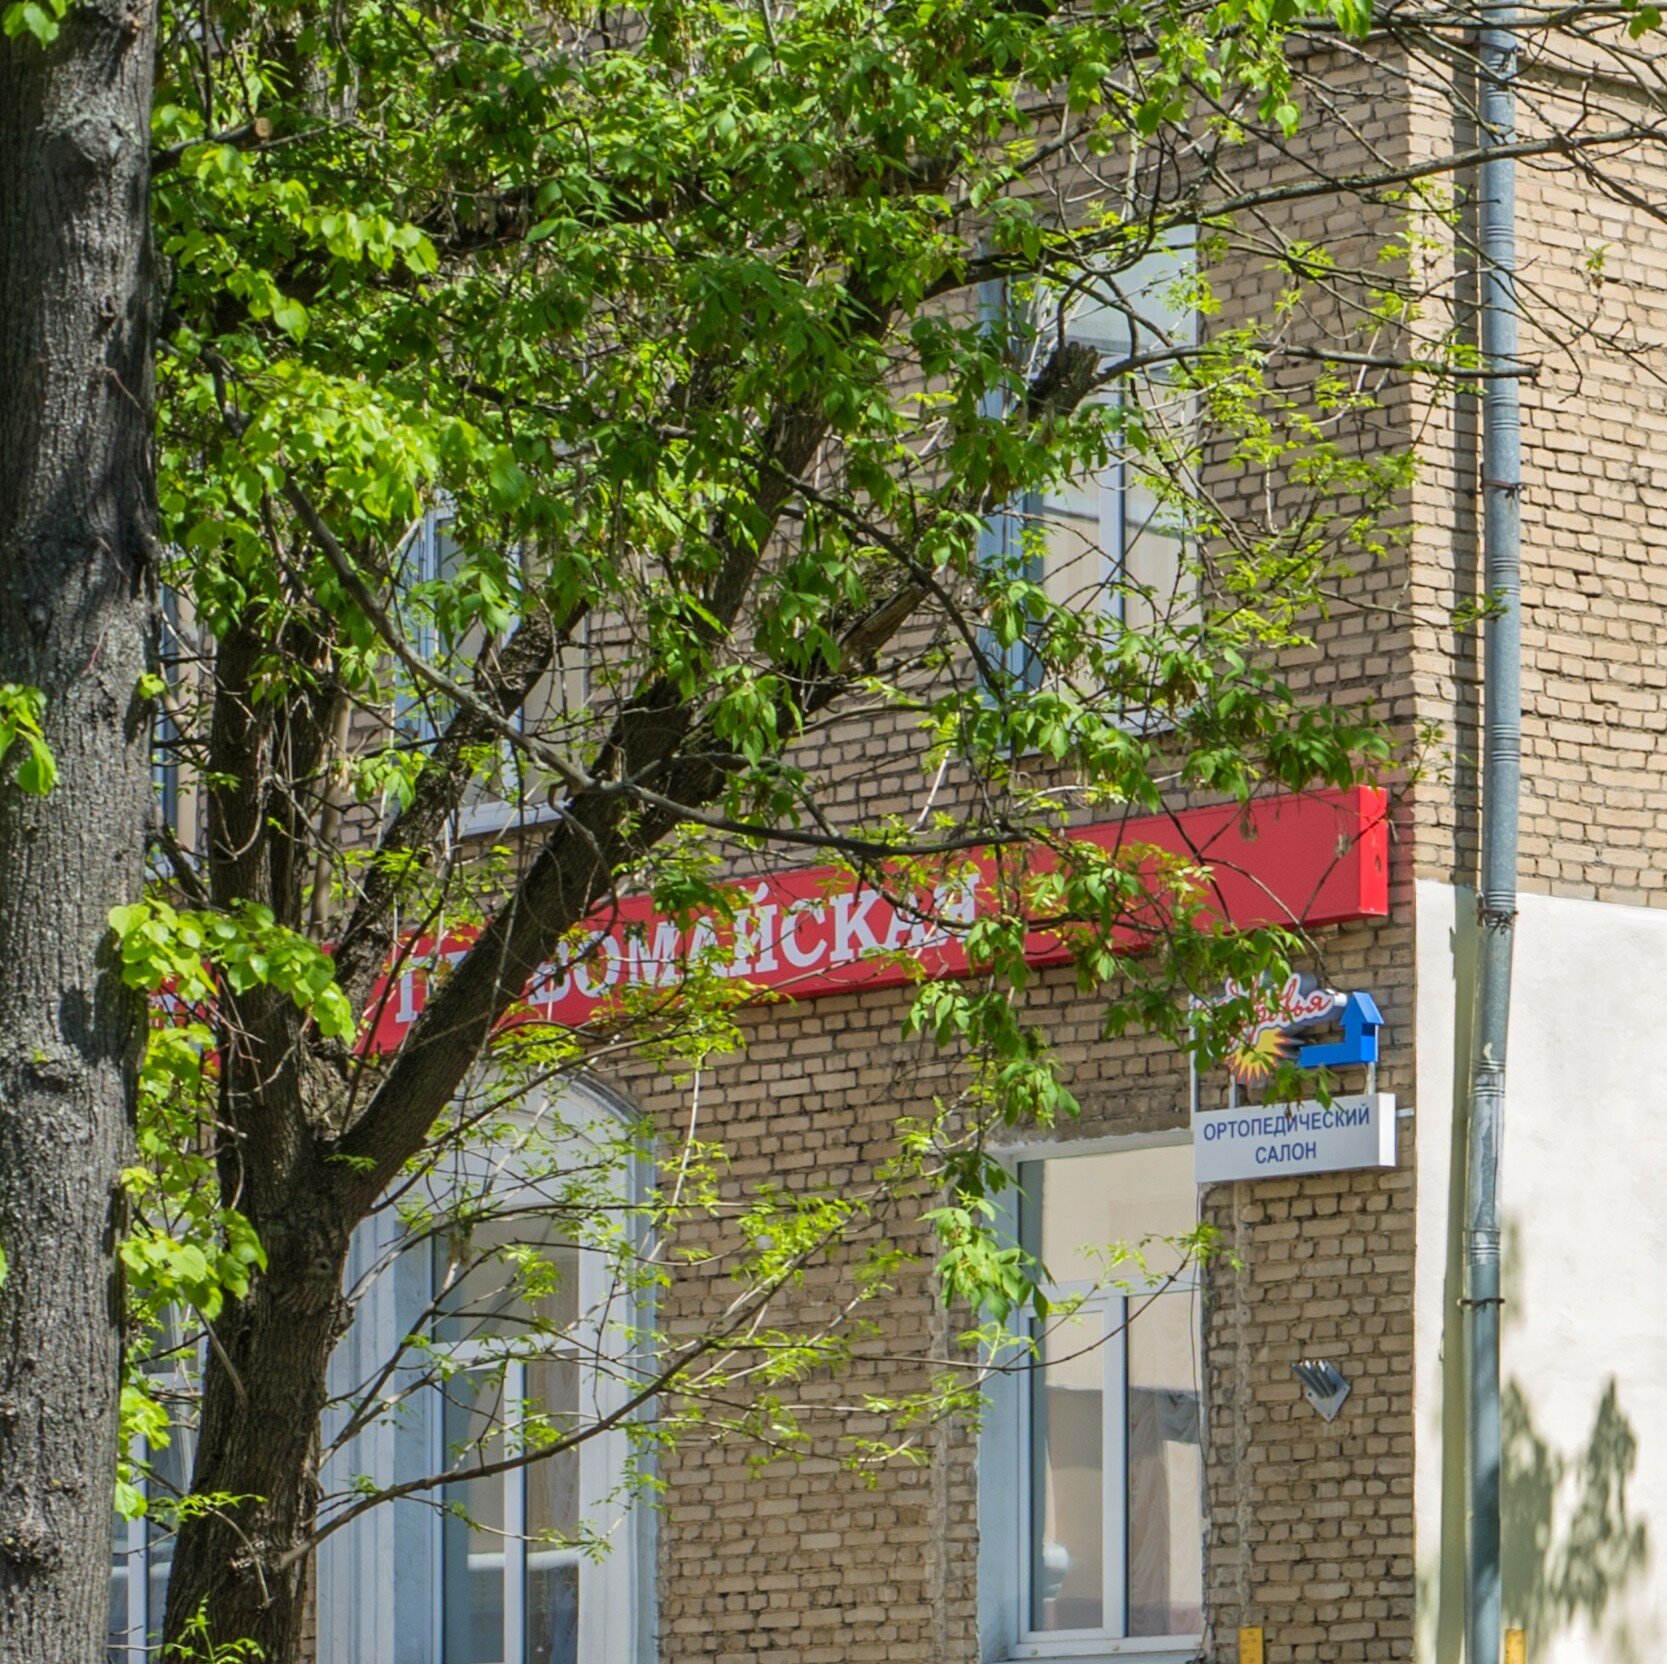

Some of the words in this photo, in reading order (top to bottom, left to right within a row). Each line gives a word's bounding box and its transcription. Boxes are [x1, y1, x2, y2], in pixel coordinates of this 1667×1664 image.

[394, 872, 981, 1024] ПВОМАЙСКАЯ
[1203, 1102, 1371, 1141] ОРТОПЕДИЧЕСКИЙ
[1255, 1142, 1317, 1164] САЛОН
